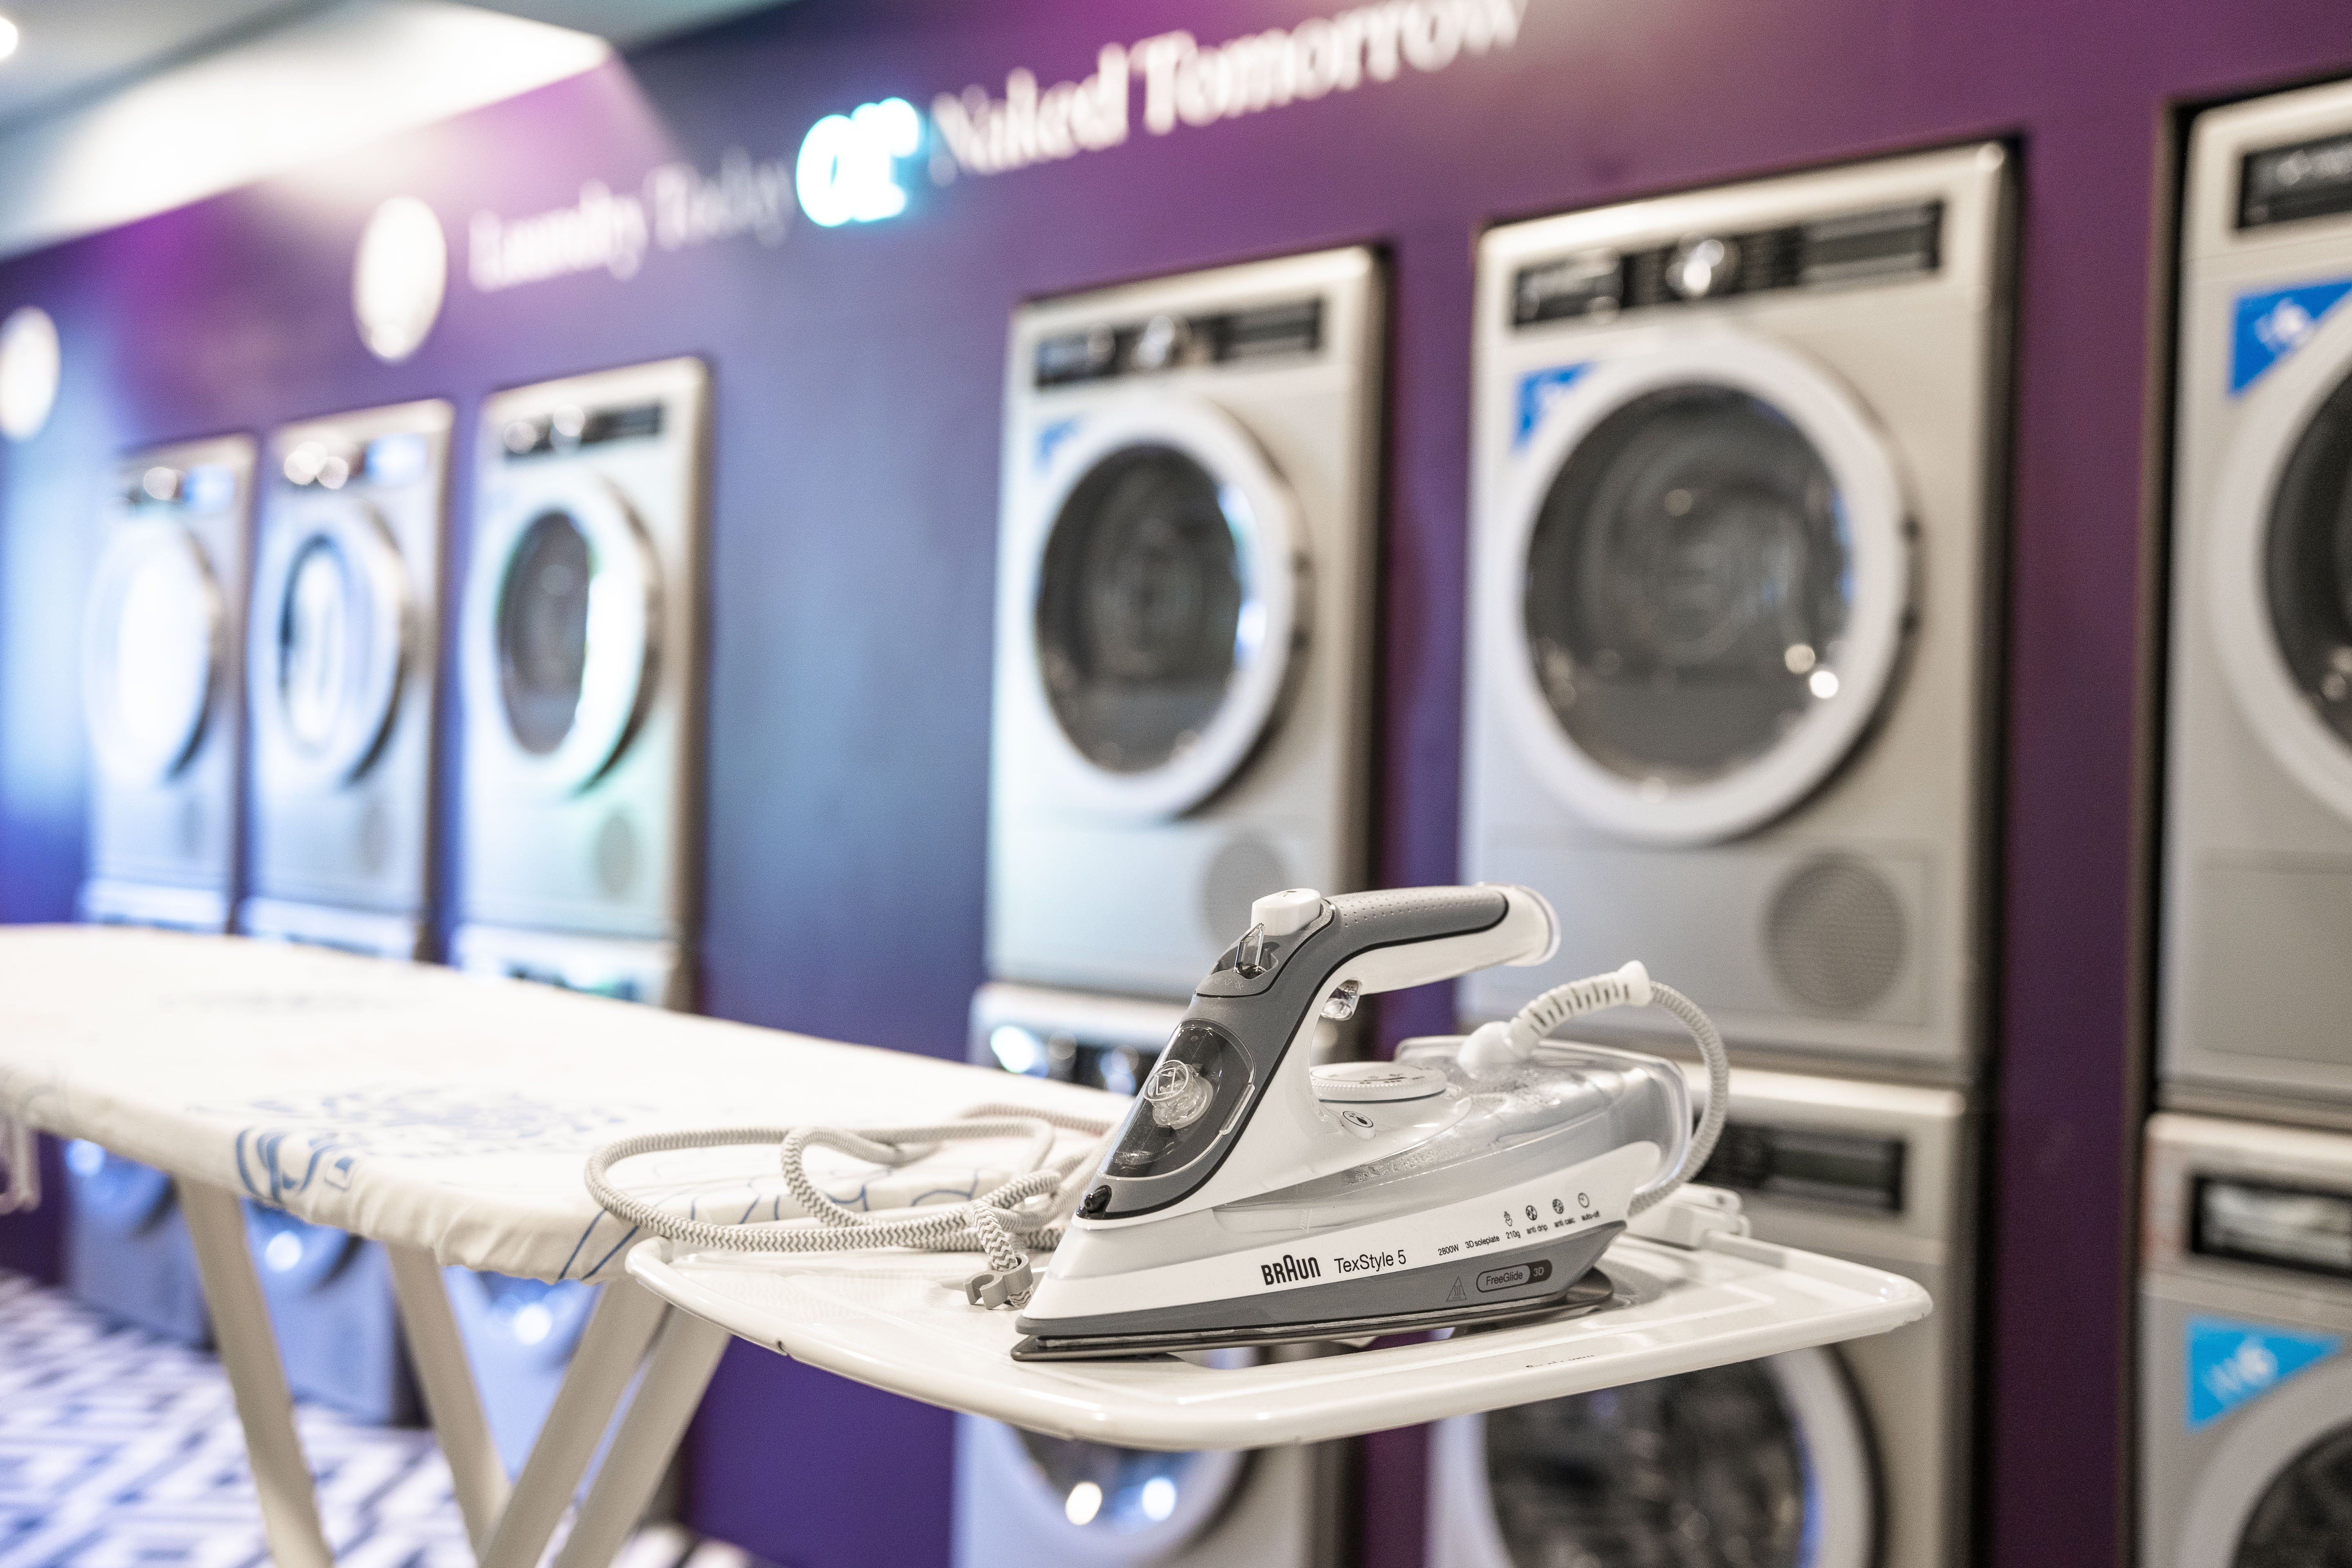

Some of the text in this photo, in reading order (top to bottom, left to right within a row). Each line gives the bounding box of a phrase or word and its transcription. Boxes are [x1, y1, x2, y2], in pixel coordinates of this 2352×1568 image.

[928, 42, 1129, 185] Naked
[1537, 1223, 1548, 1232] drip
[1565, 1217, 1575, 1225] calc
[1506, 1230, 1521, 1239] 210g
[1465, 1235, 1500, 1249] 3D soleplate
[1438, 1244, 1459, 1256] 2800W
[1334, 1249, 1406, 1273] TexStyle 5
[1261, 1254, 1321, 1285] BRAUN
[1486, 1267, 1544, 1285] FreeGlide 3D
